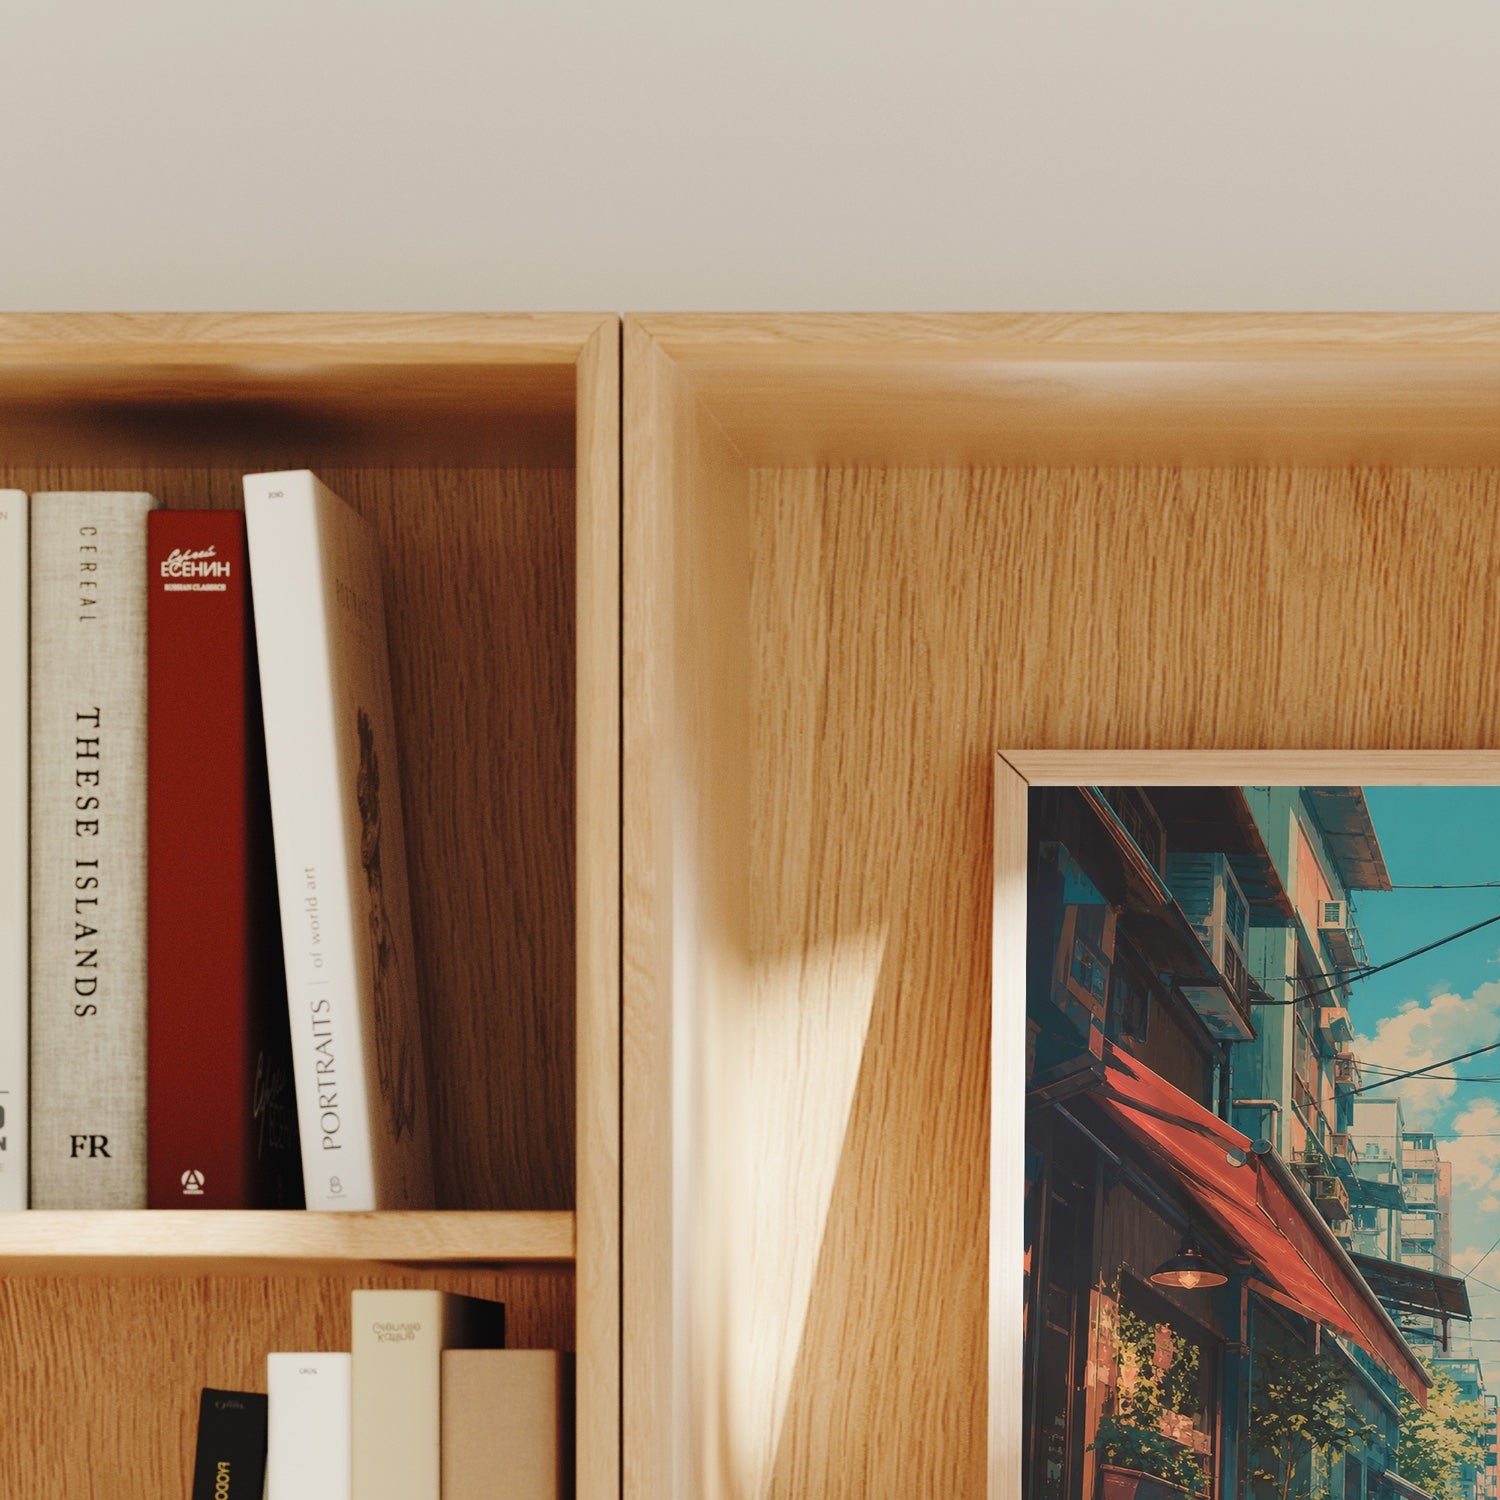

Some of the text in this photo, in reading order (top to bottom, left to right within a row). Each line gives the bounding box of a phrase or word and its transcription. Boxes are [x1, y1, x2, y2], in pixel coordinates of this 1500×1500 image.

[79, 526, 97, 623] CEREAL
[160, 561, 231, 578] ЕСЕНИН
[74, 707, 100, 1018] THESE ISLANDS
[303, 867, 342, 1150] PORTRAITS of world art
[69, 1134, 112, 1158] FR
